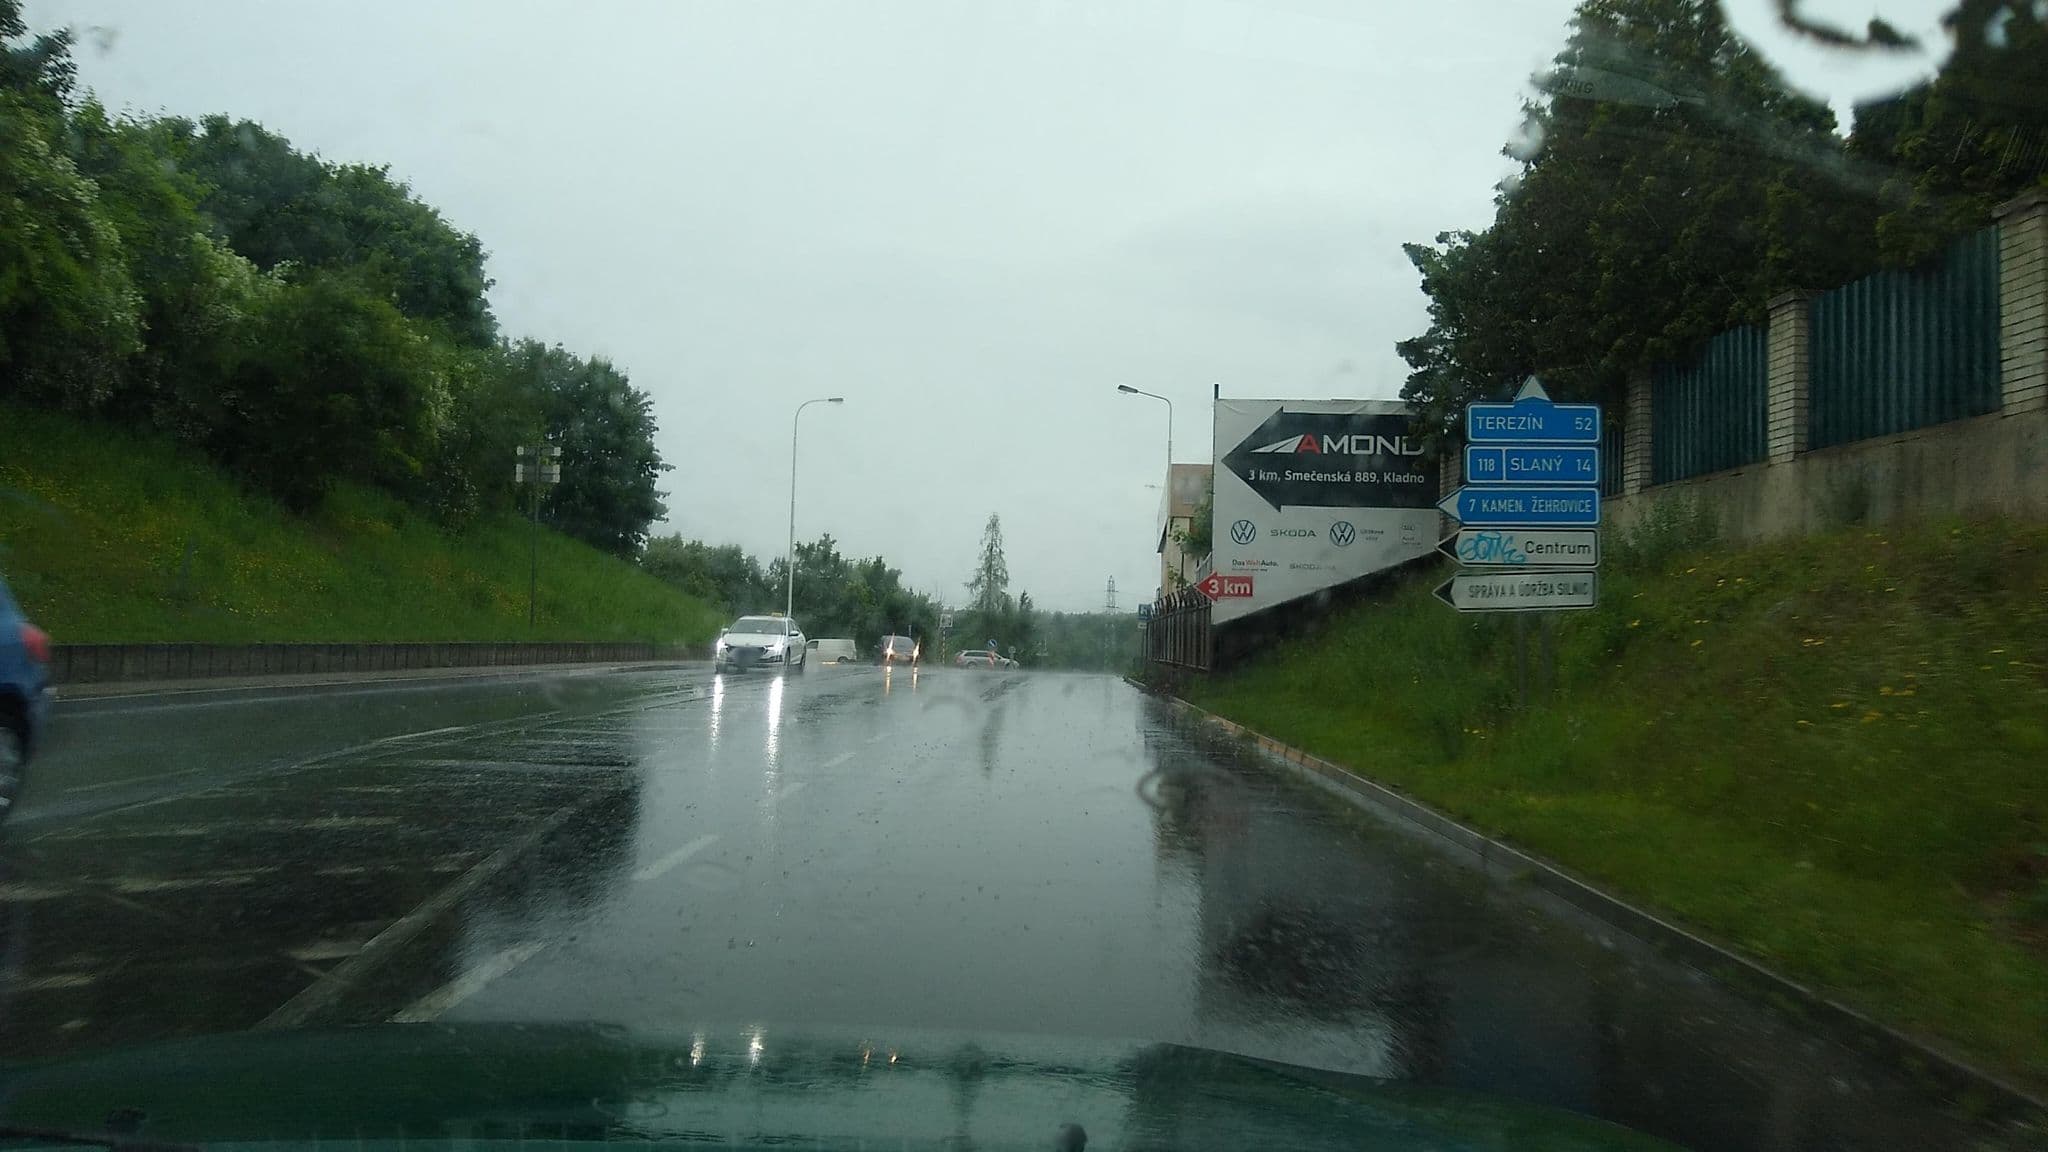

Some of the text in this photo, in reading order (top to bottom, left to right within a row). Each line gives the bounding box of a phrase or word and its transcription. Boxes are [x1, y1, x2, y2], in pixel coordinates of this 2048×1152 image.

[1476, 413, 1592, 431] TEREZÍN 52
[1478, 454, 1591, 472] 118 SLANÝ 14
[1248, 469, 1425, 484] 3 km, Smečenská 889, Kladno
[1468, 496, 1592, 513] 7 KAMEN. ŽEHROVICE
[1525, 541, 1591, 555] Centrum
[1208, 578, 1251, 595] 3 km
[1468, 582, 1506, 598] SPRÁVA
[1509, 584, 1516, 597] A
